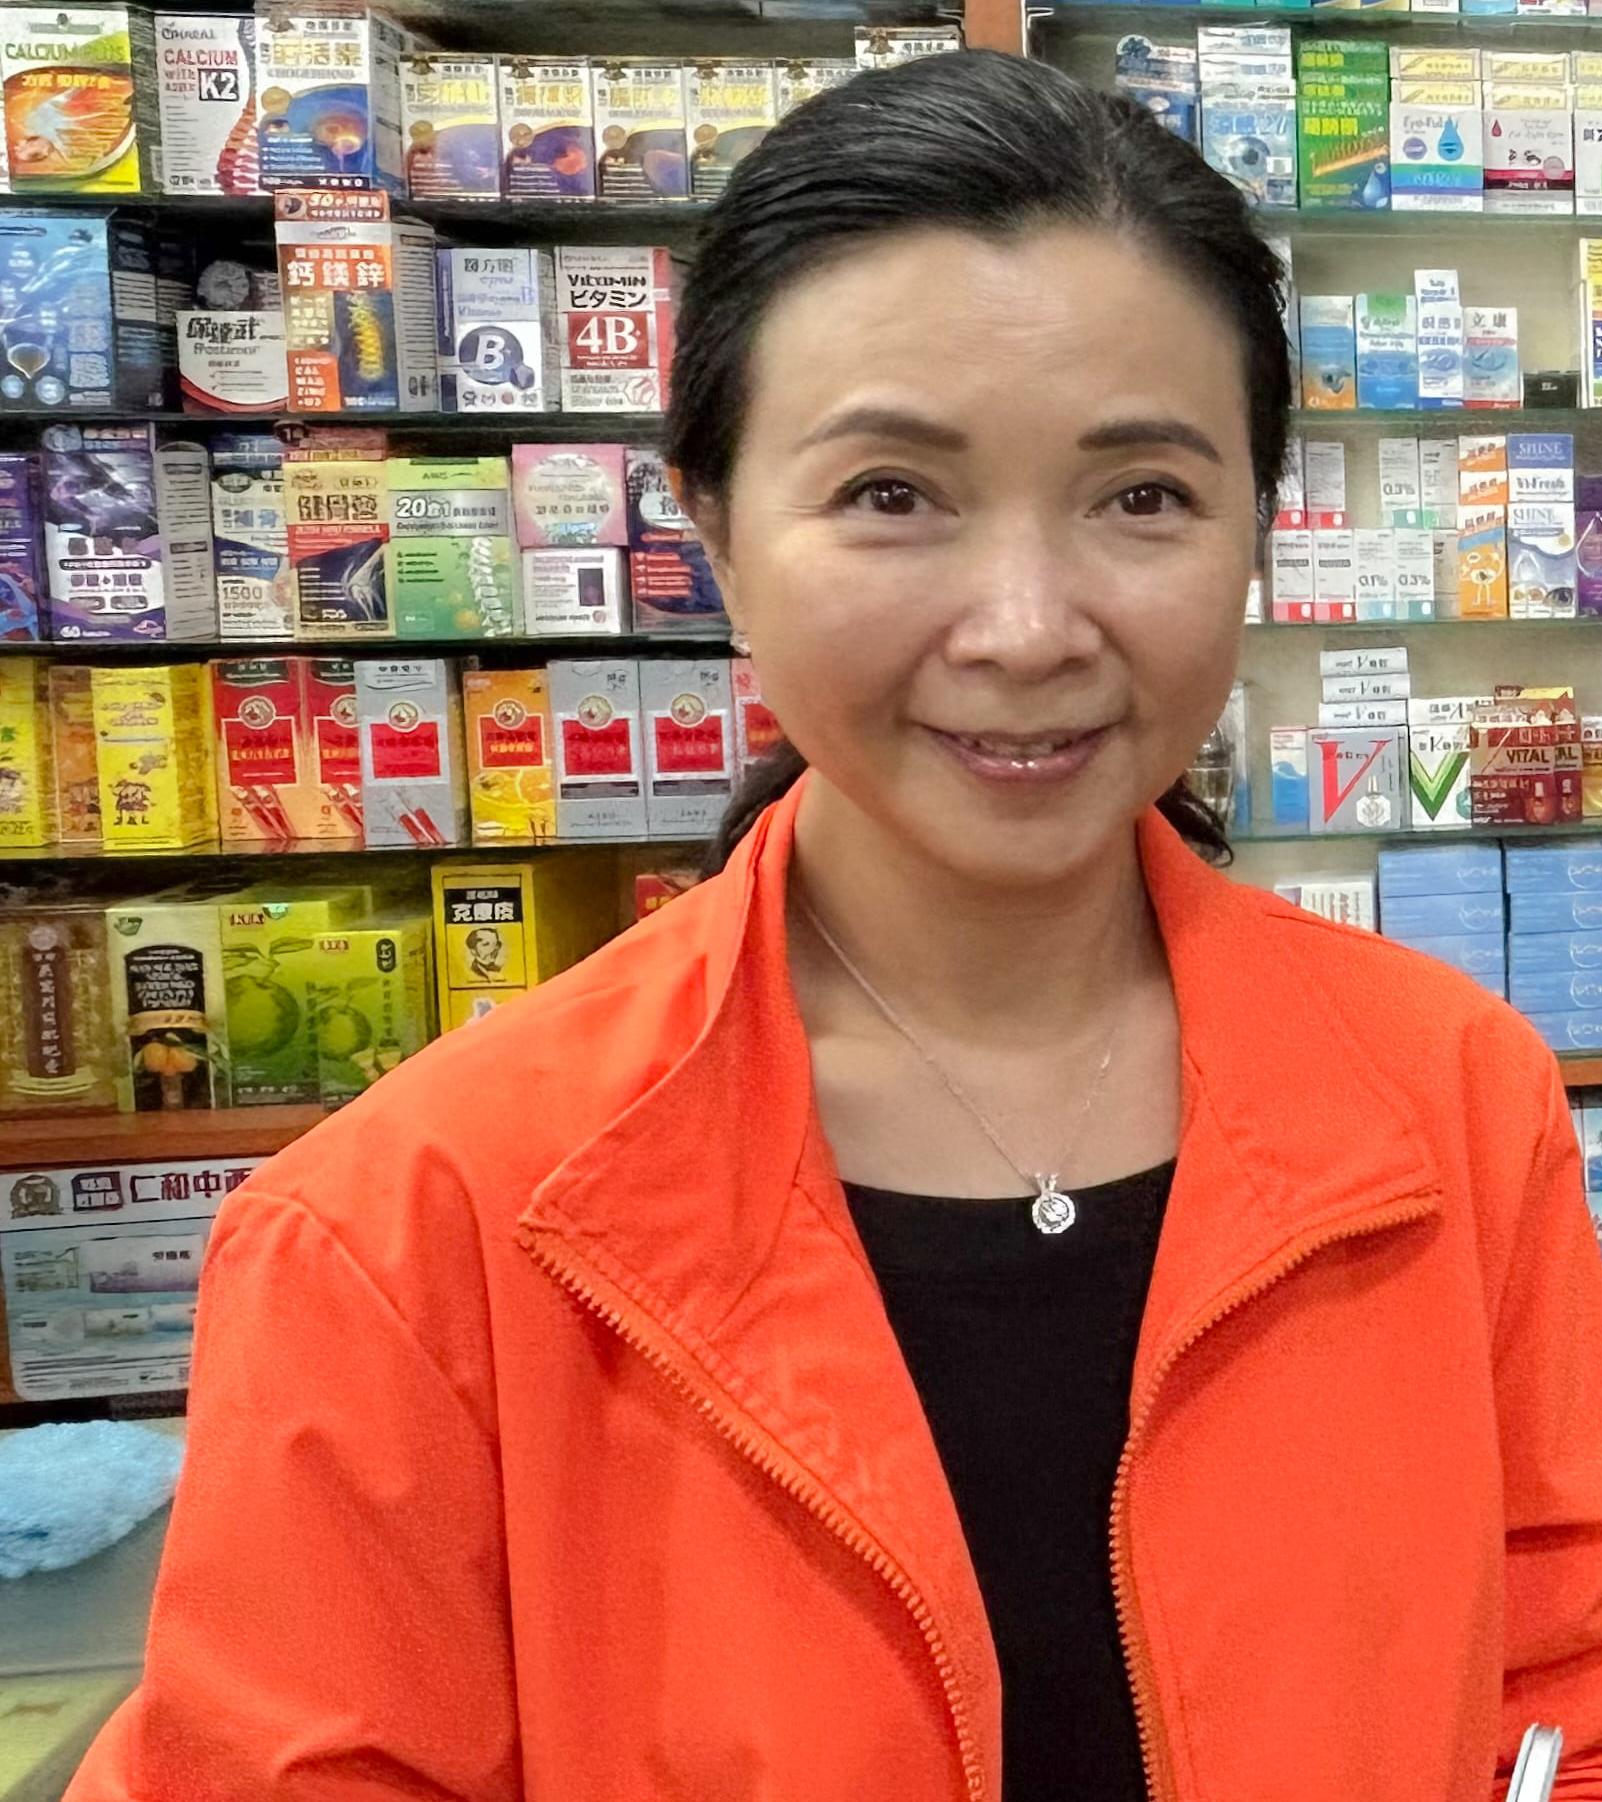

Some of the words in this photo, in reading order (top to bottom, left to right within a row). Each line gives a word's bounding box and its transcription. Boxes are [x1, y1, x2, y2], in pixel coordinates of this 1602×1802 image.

[164, 49, 238, 66] CALCIUM
[201, 70, 238, 98] K2
[570, 289, 648, 308] ビタミン
[575, 315, 637, 355] 4B
[1506, 749, 1549, 763] VITAL
